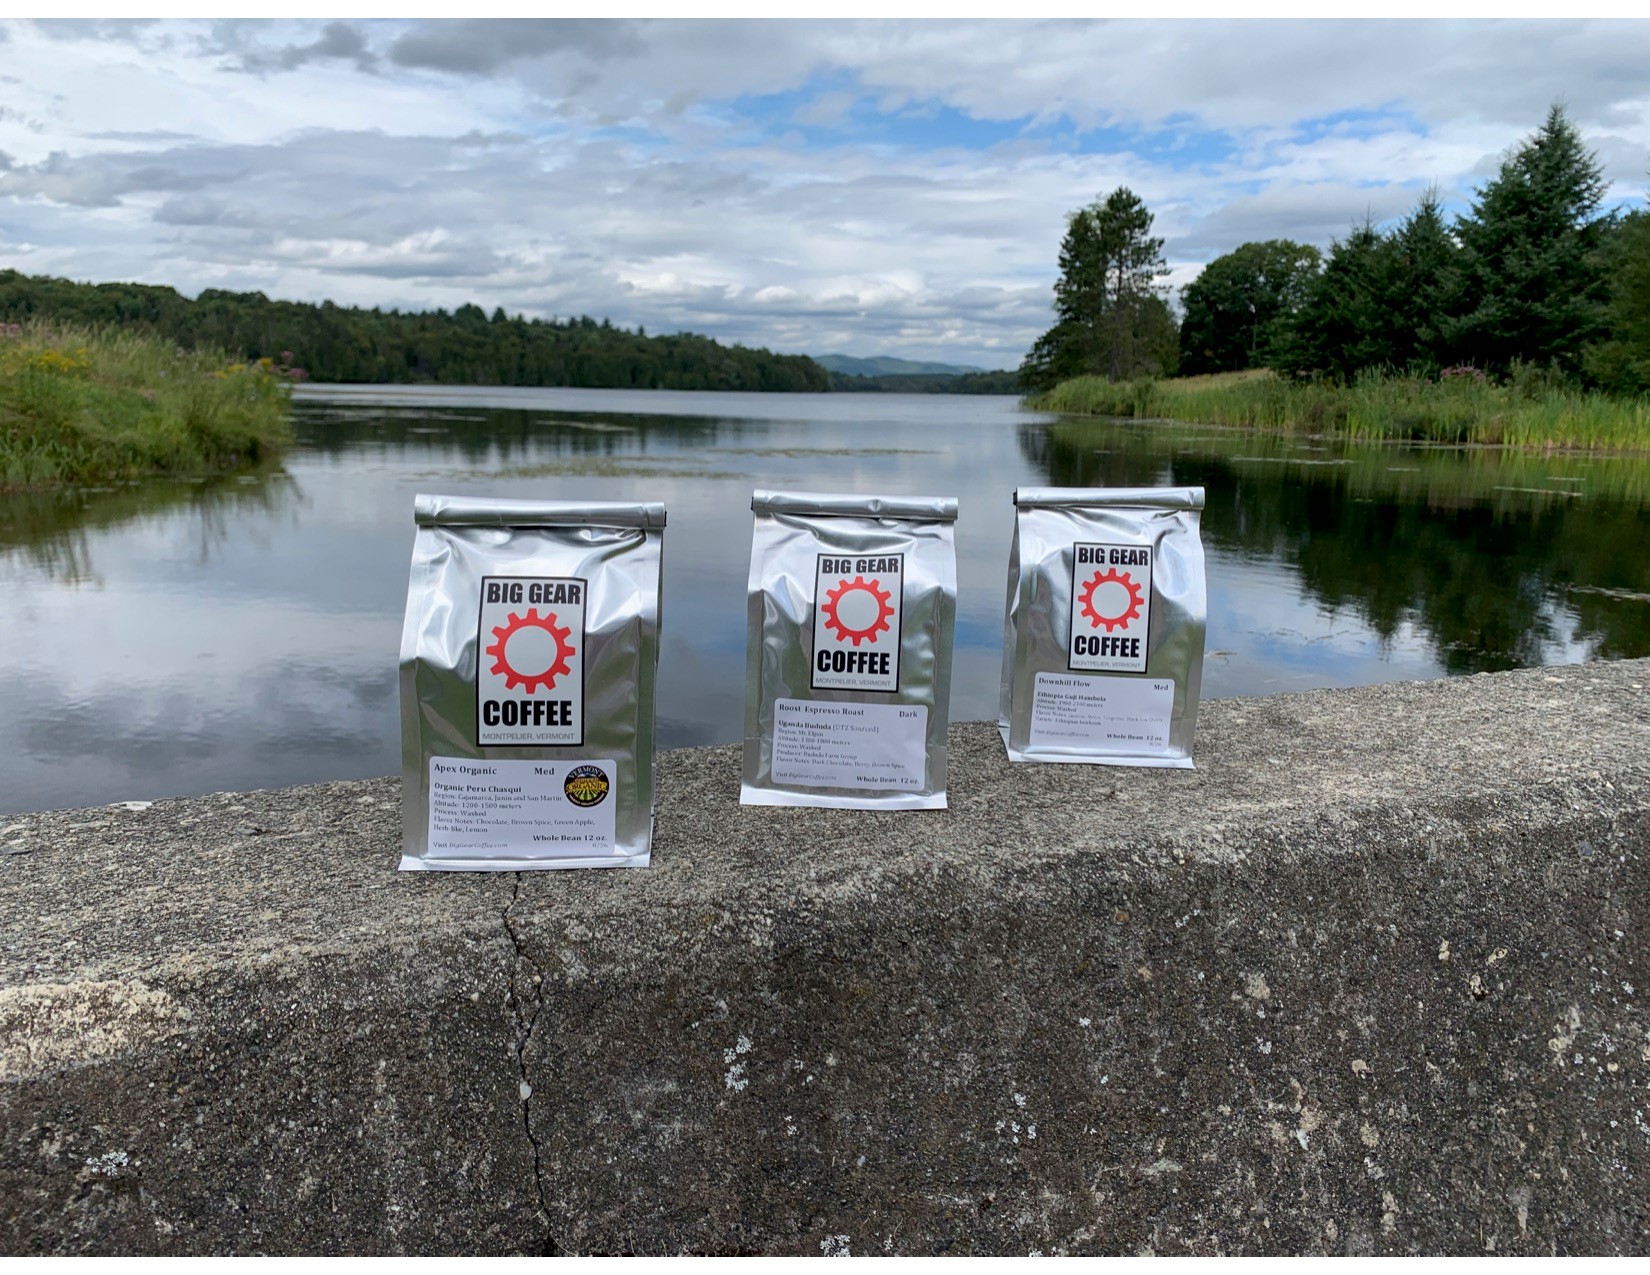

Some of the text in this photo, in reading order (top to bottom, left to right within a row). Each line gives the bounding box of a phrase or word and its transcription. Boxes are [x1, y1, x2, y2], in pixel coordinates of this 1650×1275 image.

[1078, 547, 1149, 566] BIG GEAR
[822, 558, 899, 574] BIG GEAR
[487, 583, 581, 605] BIG GEAR
[1074, 635, 1140, 658] COFFEE
[817, 650, 890, 675] COFFEE
[815, 678, 857, 686] MONTPELIER,
[1038, 677, 1071, 686] Downhill
[1037, 691, 1063, 699] Ethiopia
[483, 700, 572, 726] COFFEE
[779, 703, 801, 712] Roost
[805, 705, 840, 715] Espresso
[899, 710, 918, 718] Dark
[779, 720, 803, 728] Uganda
[482, 732, 533, 740] MONTPELIER,
[434, 763, 555, 776] Apex Organic Med
[568, 765, 605, 778] VERMONT
[856, 775, 878, 783] Whole
[434, 782, 522, 794] Organic Peru Chasqui
[567, 781, 607, 791] ORGANIC
[434, 799, 459, 807] Altitude:
[458, 793, 493, 802] Cajamarca,
[434, 815, 453, 823] Flavor
[476, 818, 510, 826] Chocolate,
[534, 818, 553, 826] Spice,
[574, 818, 595, 826] Apple,
[448, 841, 508, 849] BigGearCoffee.com
